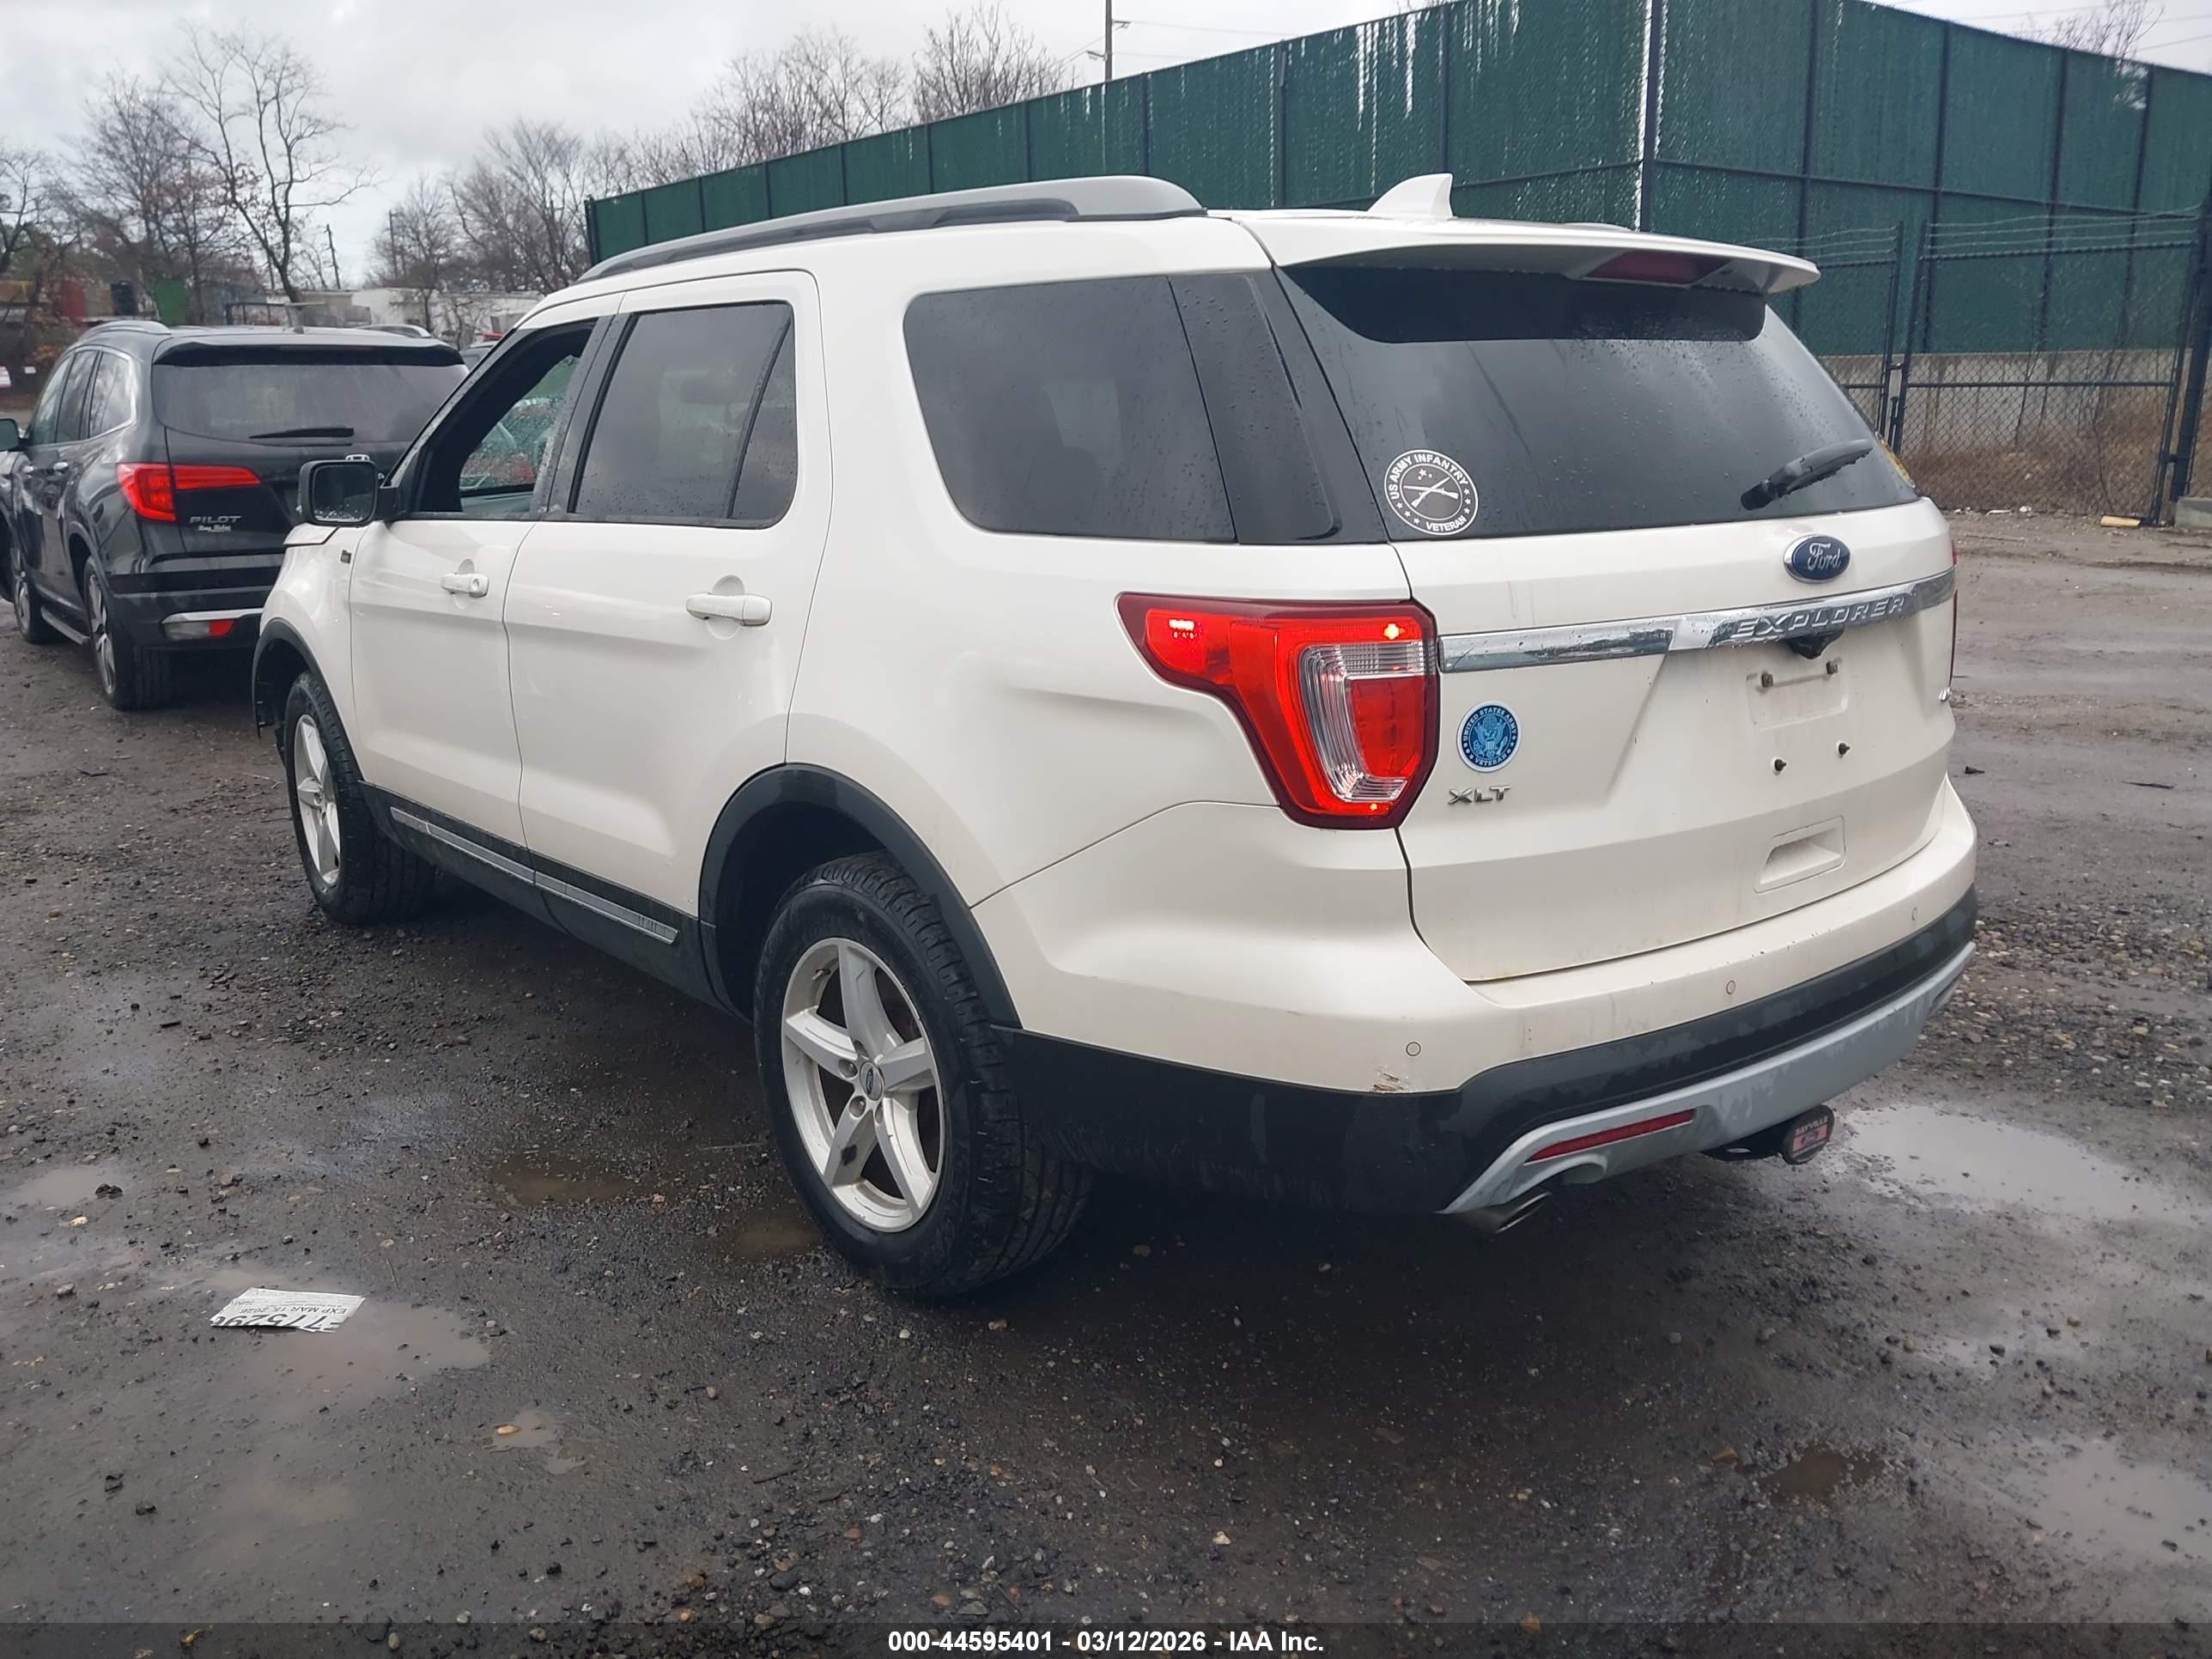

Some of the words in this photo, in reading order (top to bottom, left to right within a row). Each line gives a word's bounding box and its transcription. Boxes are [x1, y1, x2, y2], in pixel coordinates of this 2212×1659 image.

[1389, 456, 1413, 483] ARMY
[1413, 453, 1468, 486] INFANTRY
[190, 515, 241, 524] PILOT
[1425, 515, 1468, 532] VETERAN
[1808, 541, 1843, 571] Ford
[1730, 596, 1906, 639] EXPLORER
[1462, 714, 1479, 741] UNITED
[1479, 707, 1505, 716] STATES
[1504, 713, 1517, 734] ARMY
[1474, 753, 1508, 767] VETERAN
[1448, 784, 1512, 805] XLT
